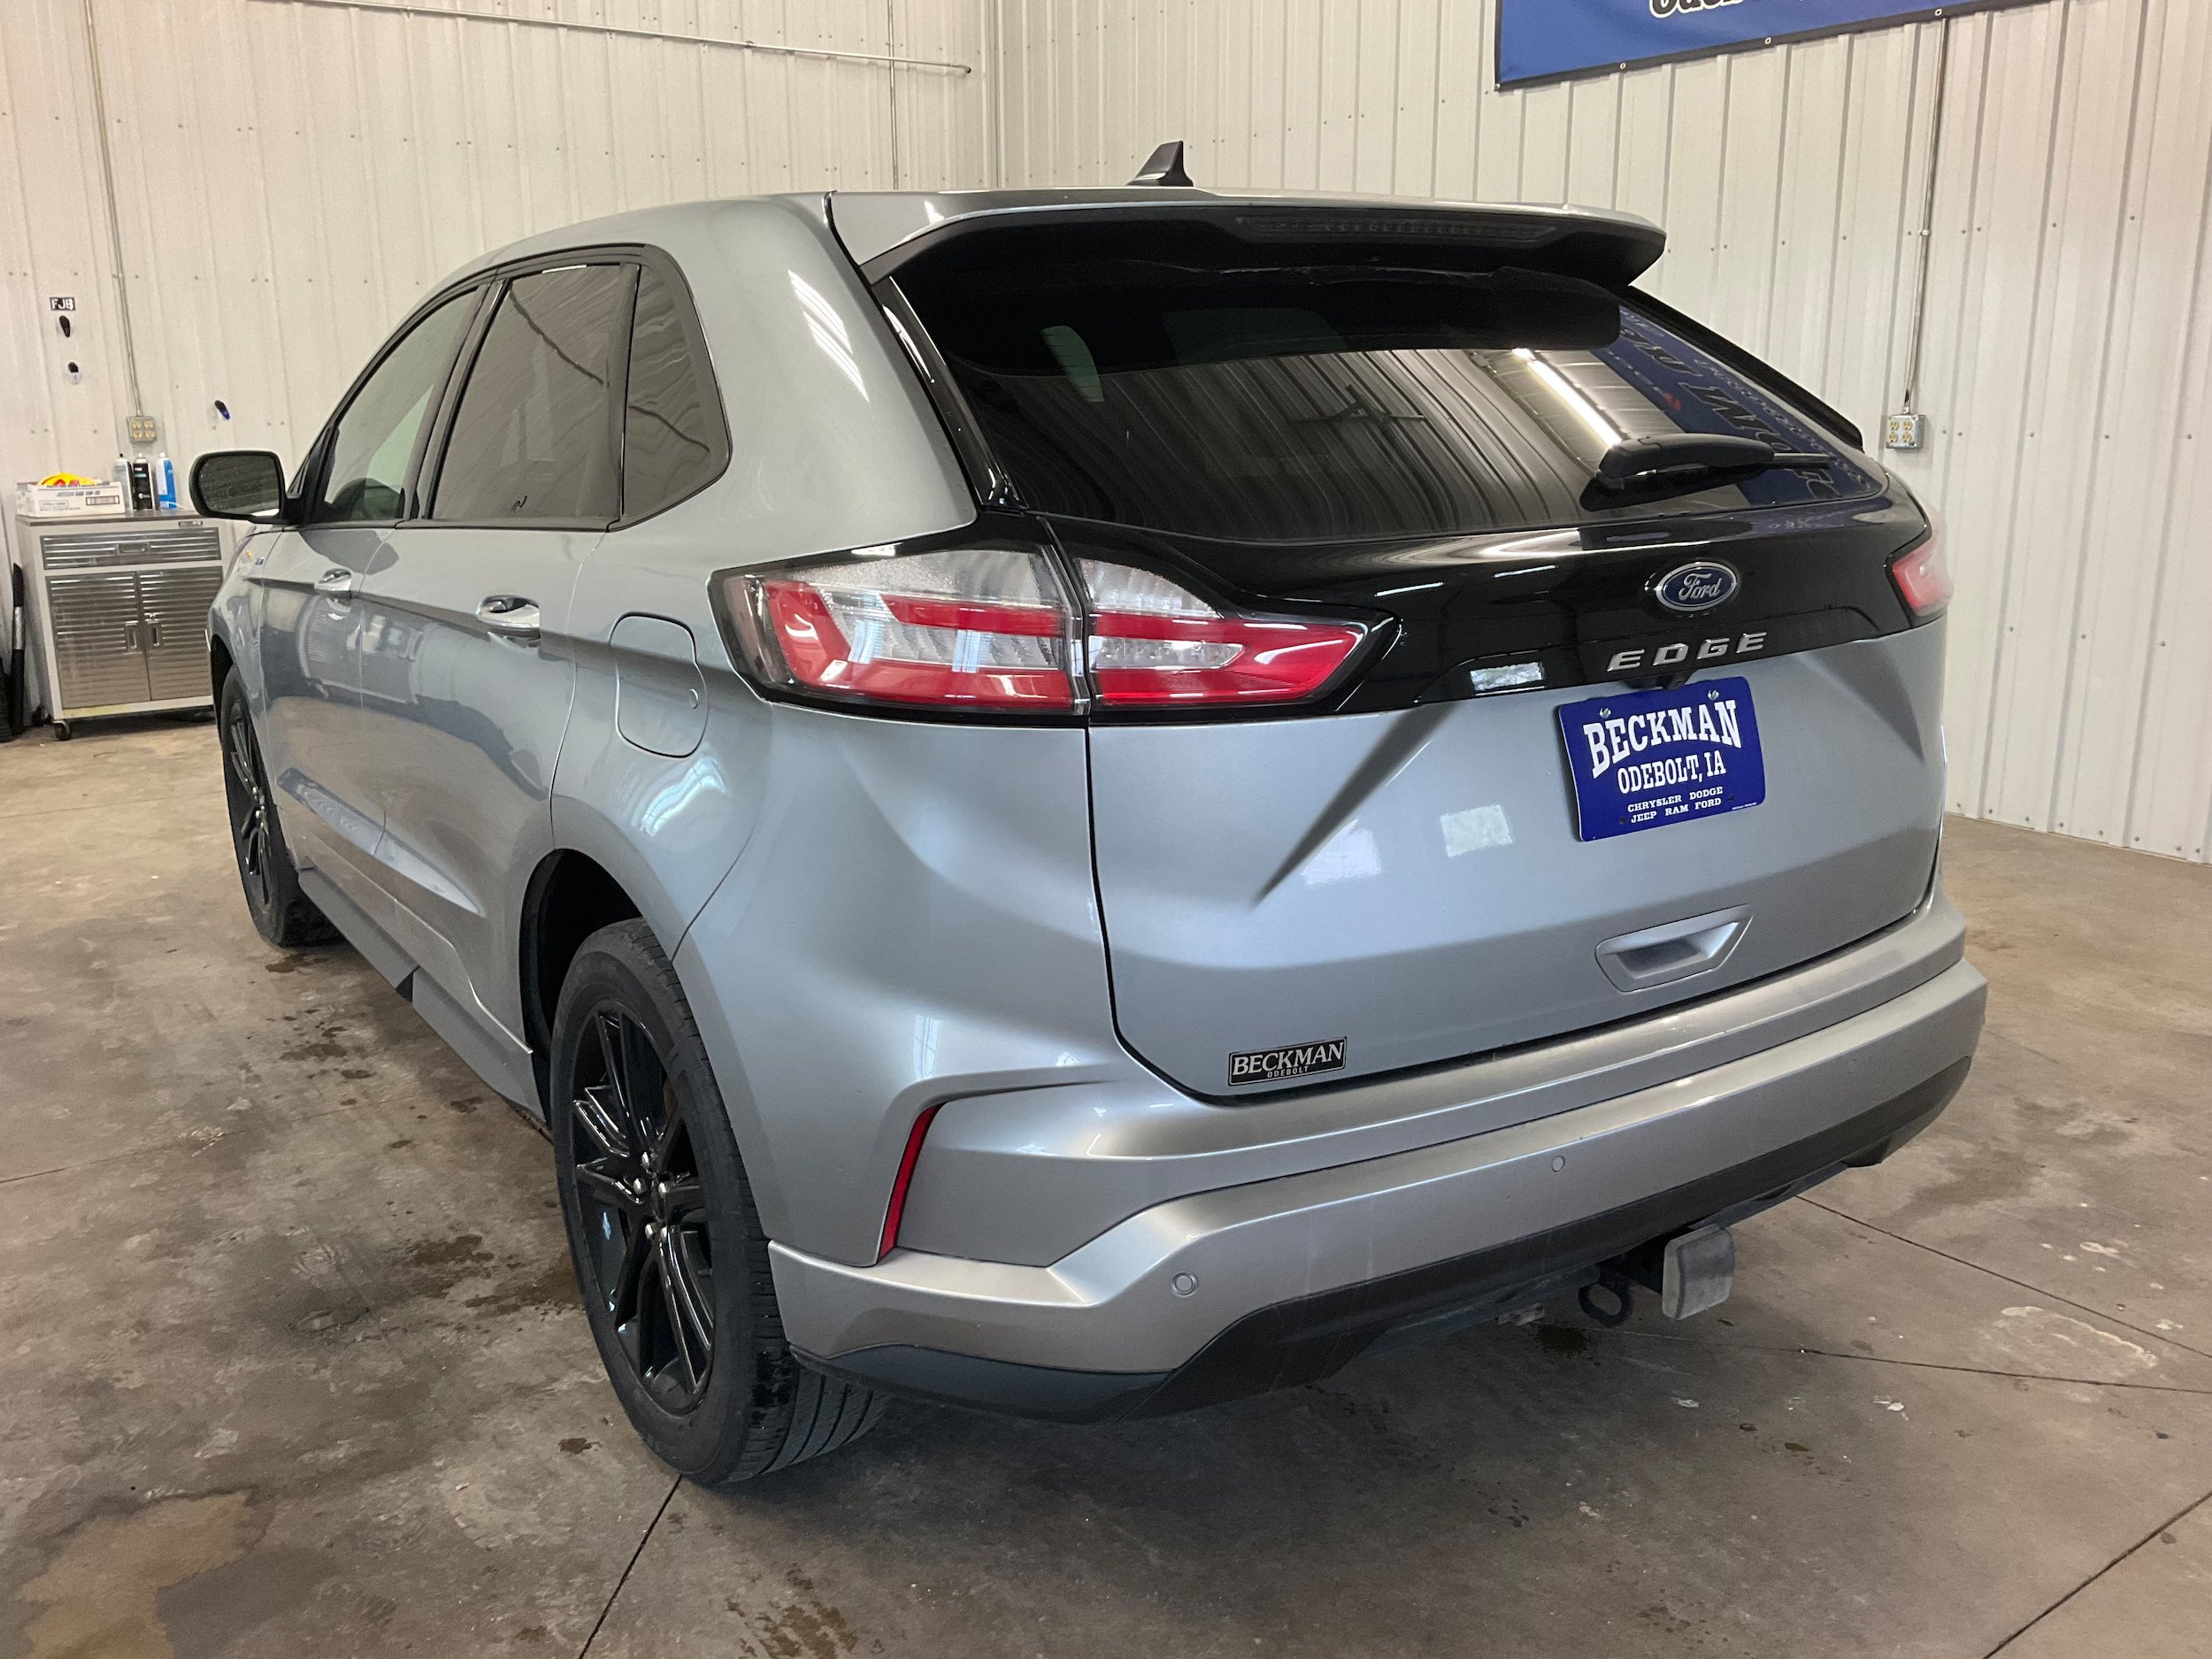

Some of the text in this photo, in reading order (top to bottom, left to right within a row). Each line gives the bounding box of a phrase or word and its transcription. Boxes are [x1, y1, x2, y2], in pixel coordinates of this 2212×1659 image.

[50, 298, 74, 311] FJB
[1678, 572, 1723, 601] Ford
[1607, 632, 1767, 672] EDGE
[1582, 699, 1742, 780] BECKMAN
[1617, 749, 1727, 795] ODEBOLT, IA
[1627, 786, 1724, 813] CHRYSLER DODGE
[1630, 810, 1658, 824] JEEP
[1664, 803, 1689, 817] RAM
[1694, 797, 1722, 810] FORD
[1232, 1041, 1344, 1076] BECKMAN
[1266, 1065, 1310, 1079] ODEBOLT
